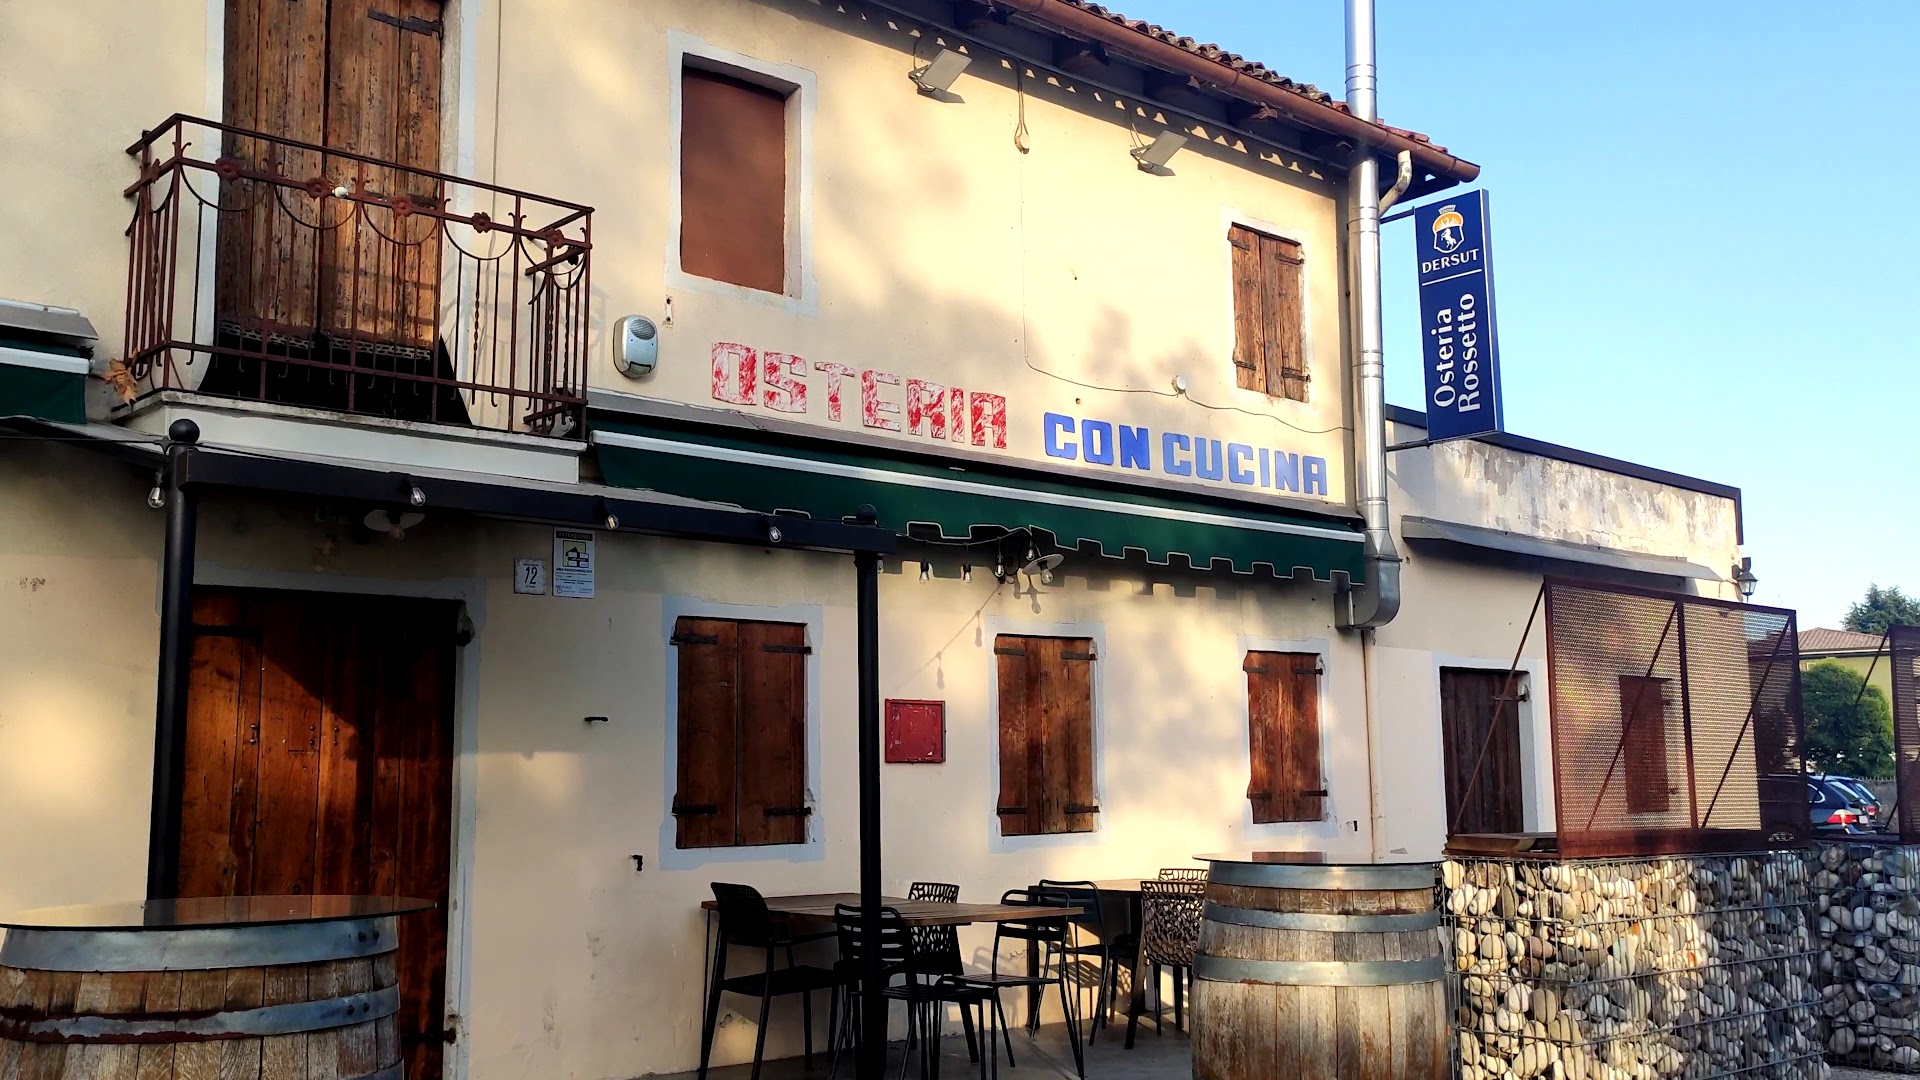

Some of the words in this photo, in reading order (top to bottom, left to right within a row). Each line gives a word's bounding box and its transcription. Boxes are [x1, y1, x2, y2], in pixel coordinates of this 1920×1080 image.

[1421, 248, 1480, 274] DERSUT
[1430, 307, 1456, 408] Osteria
[1457, 293, 1481, 413] Rossetto
[711, 341, 1007, 450] OSTERIA
[1043, 411, 1152, 471] CON
[1162, 432, 1328, 496] CUCINA
[524, 566, 538, 585] 12
